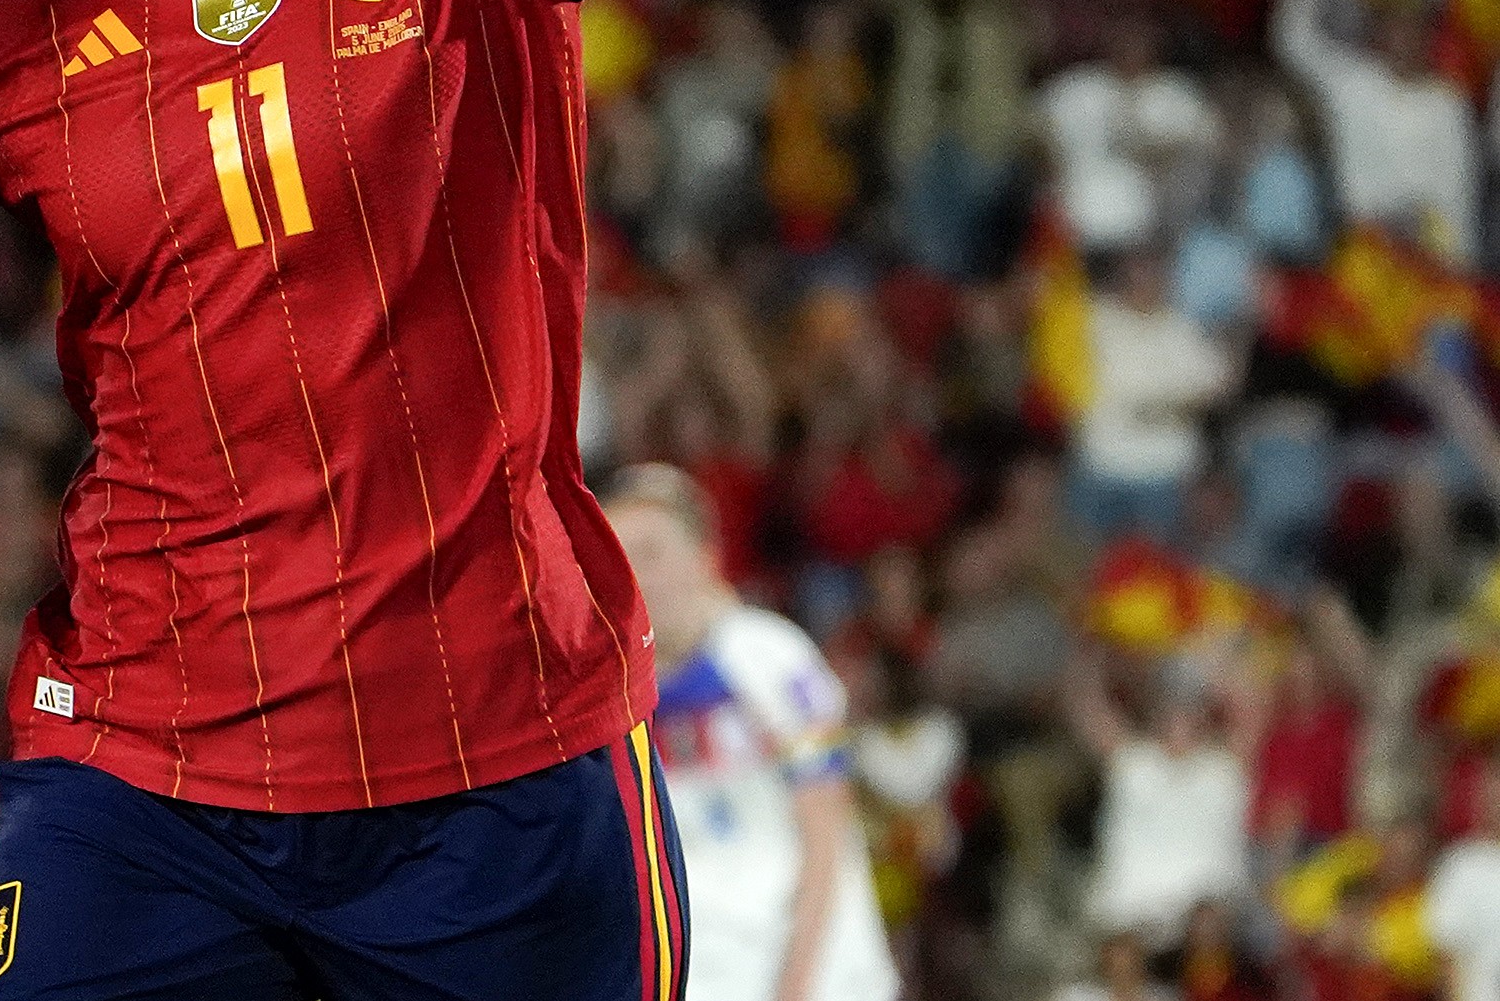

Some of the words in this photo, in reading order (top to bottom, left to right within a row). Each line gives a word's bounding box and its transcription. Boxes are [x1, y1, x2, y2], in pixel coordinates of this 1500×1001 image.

[218, 2, 259, 26] FIFA
[341, 23, 369, 38] SPAIN
[378, 8, 412, 30] ENGLAND
[227, 21, 249, 36] 2023
[352, 36, 359, 46] 5
[362, 31, 386, 44] JUNE
[336, 46, 368, 59] PALMA
[368, 42, 382, 54] DE
[383, 26, 424, 50] MALLORCA
[197, 61, 315, 250] 11
